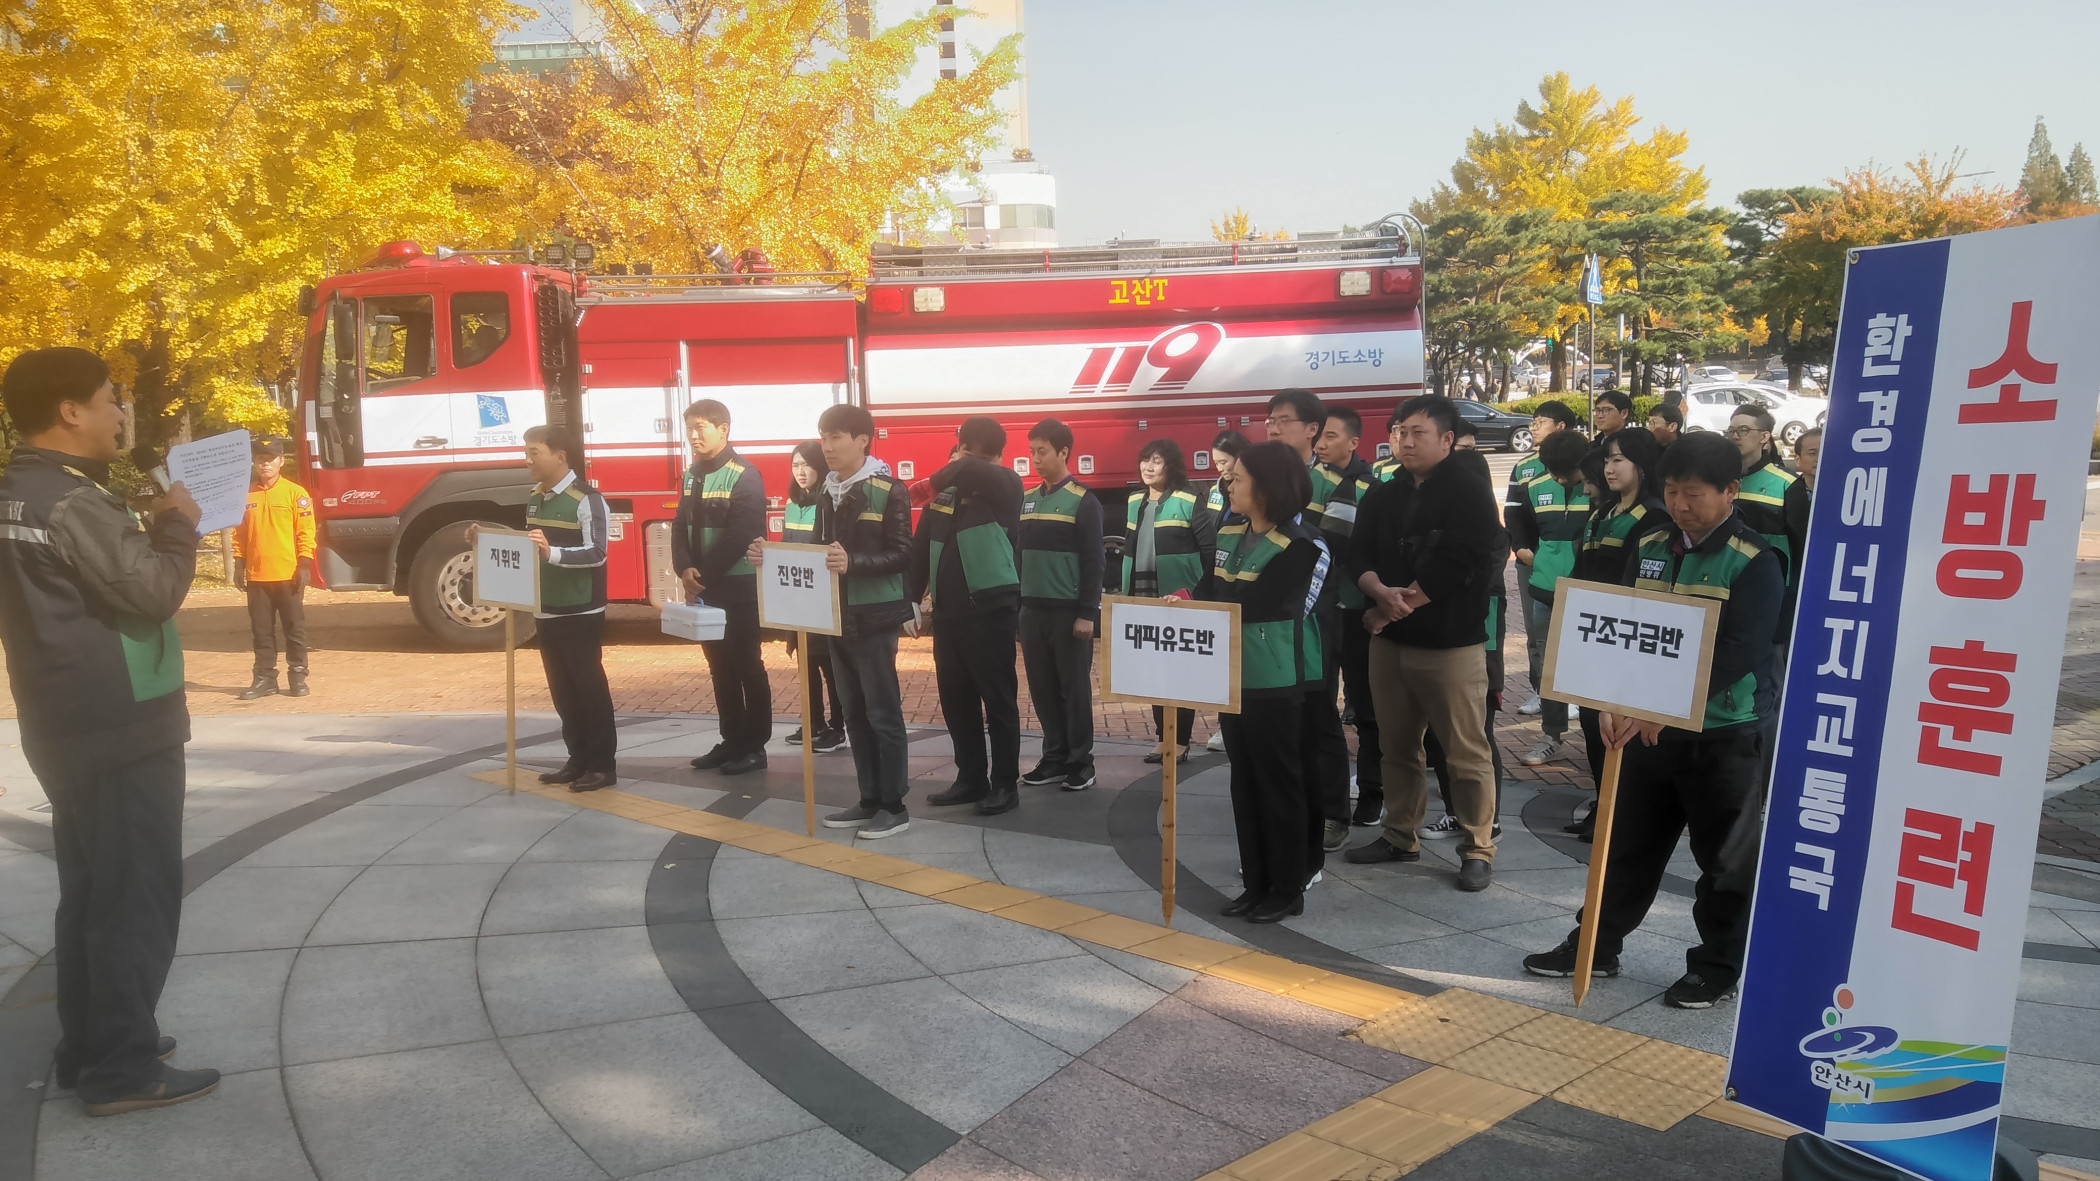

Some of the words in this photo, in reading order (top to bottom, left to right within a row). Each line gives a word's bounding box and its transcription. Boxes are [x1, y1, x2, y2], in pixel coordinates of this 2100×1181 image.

[1108, 278, 1168, 306] 고잔T
[1068, 322, 1226, 395] 119
[1305, 348, 1384, 371] 경기도소방
[473, 434, 517, 446] 경기도소방
[490, 548, 521, 570] 지휘반
[1641, 560, 1664, 571] 안산시
[777, 565, 814, 589] 진압반
[1788, 313, 1913, 912] 환경에너지교통국
[1890, 300, 2058, 952] 소방훈련
[1125, 623, 1215, 656] 대피유도반
[1577, 612, 1684, 659] 구조구급반
[1814, 1064, 1871, 1099] 안산시
